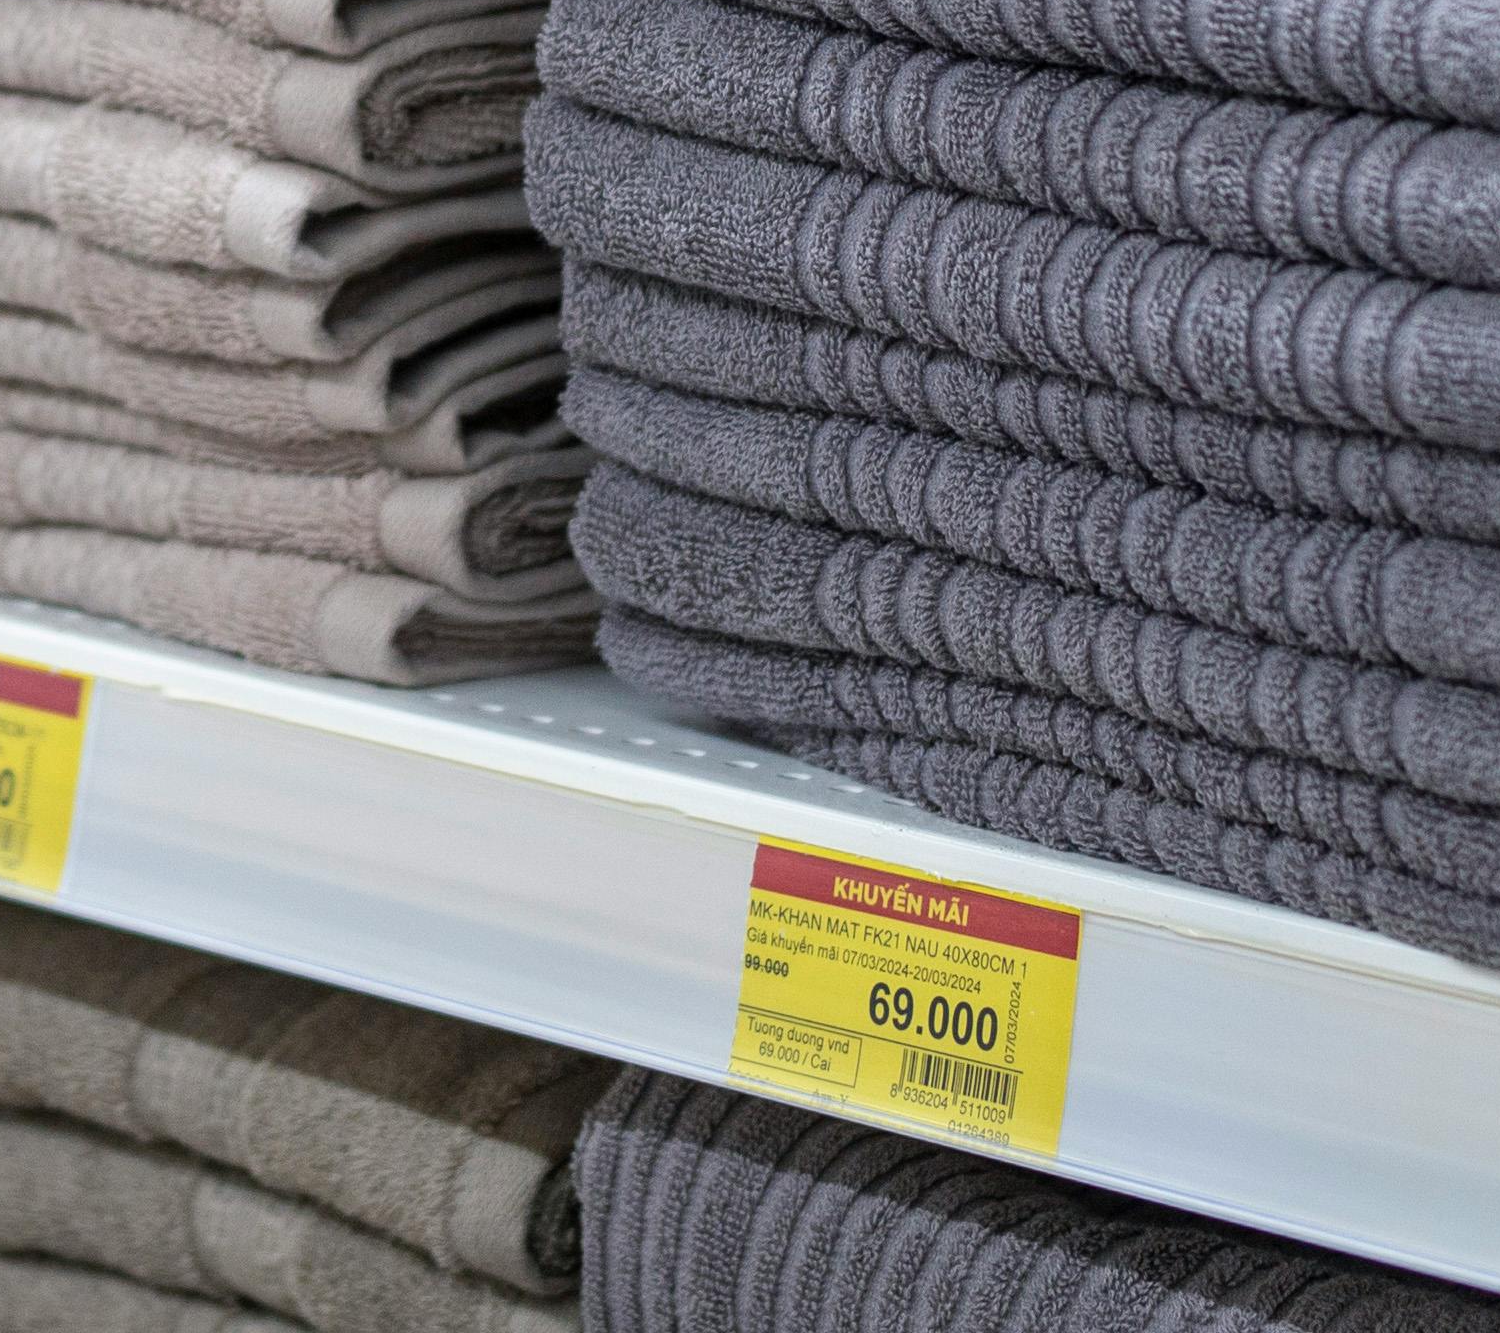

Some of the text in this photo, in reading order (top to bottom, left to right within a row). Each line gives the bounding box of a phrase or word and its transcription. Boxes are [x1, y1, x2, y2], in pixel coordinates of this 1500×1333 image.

[832, 876, 969, 927] KHUYẾN MÃI
[746, 927, 982, 995] Giá khuyến mãi 07/03/2024-20/03/2024
[749, 900, 822, 931] MK-KHAN
[826, 915, 860, 940] MAT
[863, 926, 900, 948] FK21
[905, 934, 939, 959] NAU
[942, 944, 1016, 976] 40X80CM
[744, 953, 789, 978] 99.000
[747, 1016, 850, 1055] Tuong duong vnd
[868, 981, 999, 1052] 69.000
[1003, 981, 1022, 1065] 07/03/2024
[758, 1041, 800, 1064] 69.000
[810, 1052, 832, 1072] Cai
[890, 1083, 1007, 1125] 8 936204 511009
[947, 1119, 1011, 1147] 01264389
